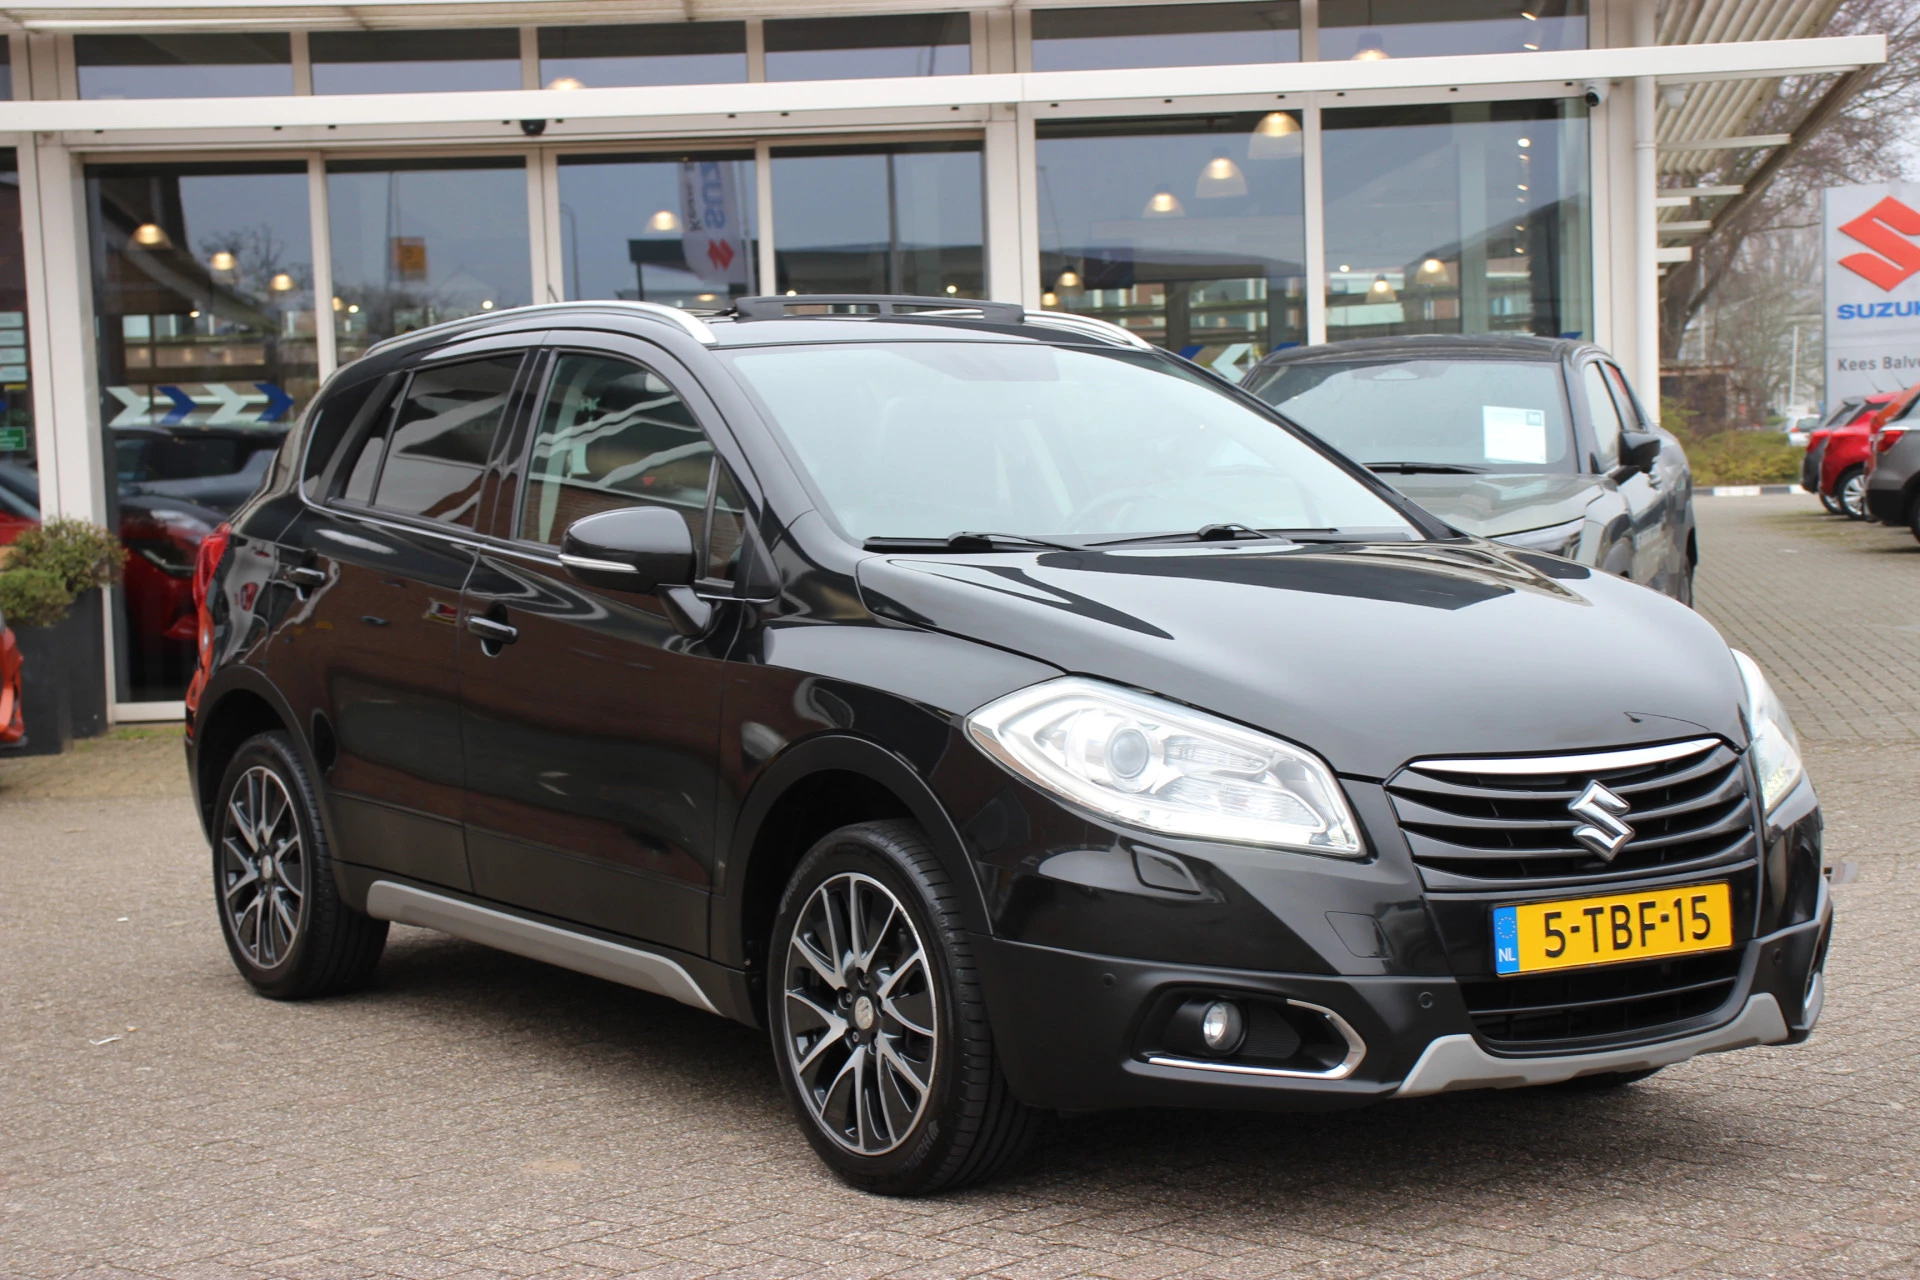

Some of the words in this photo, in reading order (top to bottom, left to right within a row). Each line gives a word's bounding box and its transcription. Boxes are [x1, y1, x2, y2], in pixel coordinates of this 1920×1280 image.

[1837, 358, 1876, 371] Kees
[1544, 895, 1711, 959] 5-TBF-15
[1498, 948, 1516, 963] NL
